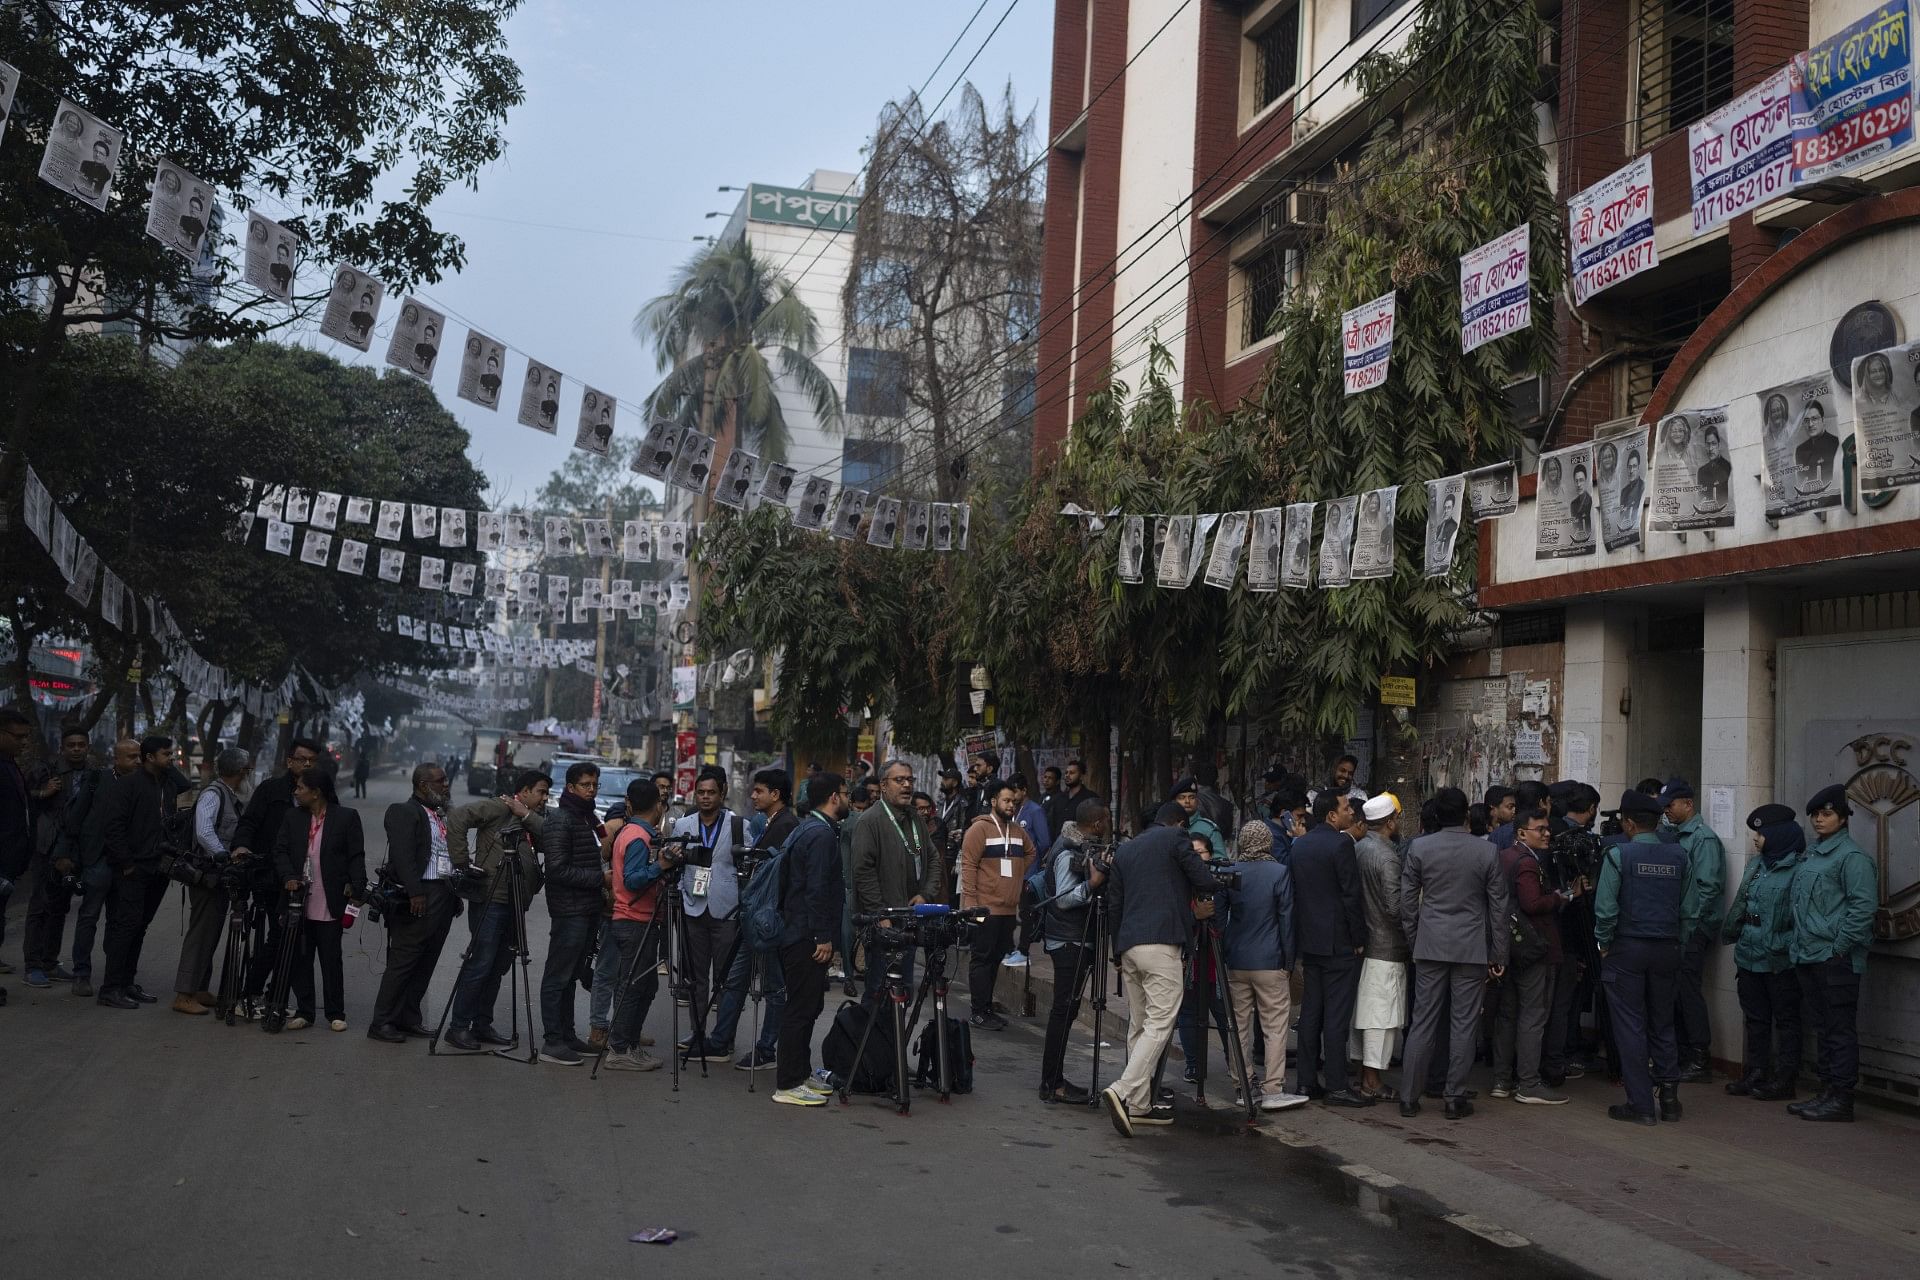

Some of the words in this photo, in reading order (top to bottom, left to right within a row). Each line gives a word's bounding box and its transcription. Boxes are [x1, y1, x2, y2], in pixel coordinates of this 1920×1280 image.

[1838, 9, 1907, 83] হোস্টেল
[1828, 83, 1876, 113] হোস্টেল
[1880, 68, 1910, 91] বিডি
[1692, 133, 1725, 176] ছাত্র
[1730, 96, 1791, 158] হোস্টেল
[1794, 97, 1910, 165] 1833-376299
[1599, 184, 1650, 237] হোস্টেল
[1694, 159, 1793, 230] 01718521677
[1463, 272, 1483, 306] ছাত্র
[1485, 248, 1527, 294] হোস্টেল
[1463, 301, 1529, 348] 01718521677
[1855, 736, 1912, 767] DCC
[1641, 865, 1671, 874] POLICE
